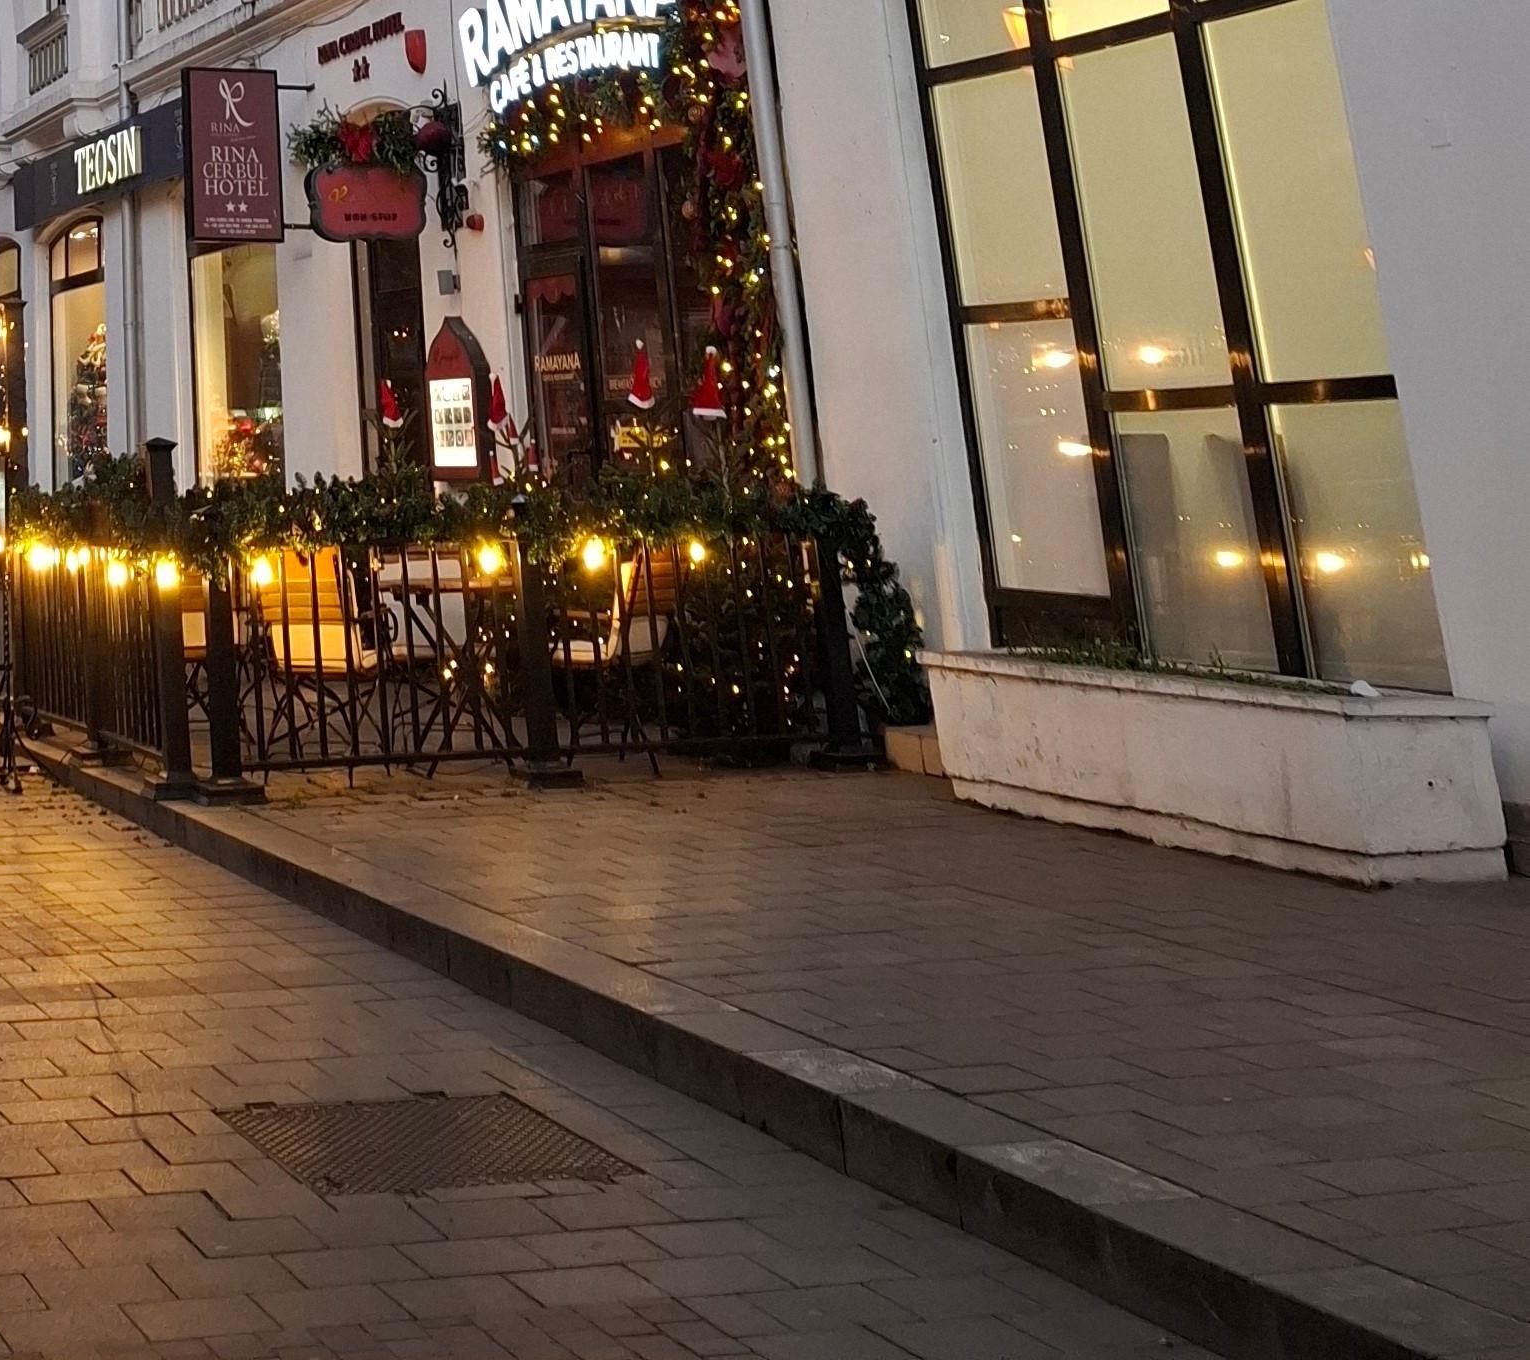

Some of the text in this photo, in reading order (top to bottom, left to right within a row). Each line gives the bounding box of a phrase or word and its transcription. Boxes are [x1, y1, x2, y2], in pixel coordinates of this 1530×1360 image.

[544, 32, 660, 81] RESTAURANT
[210, 121, 240, 134] RINA
[74, 125, 143, 195] TEOSIN
[211, 145, 259, 163] RINA
[202, 161, 268, 180] CERBUL
[204, 178, 269, 197] HOTEL
[534, 351, 581, 373] RAMAYANA
